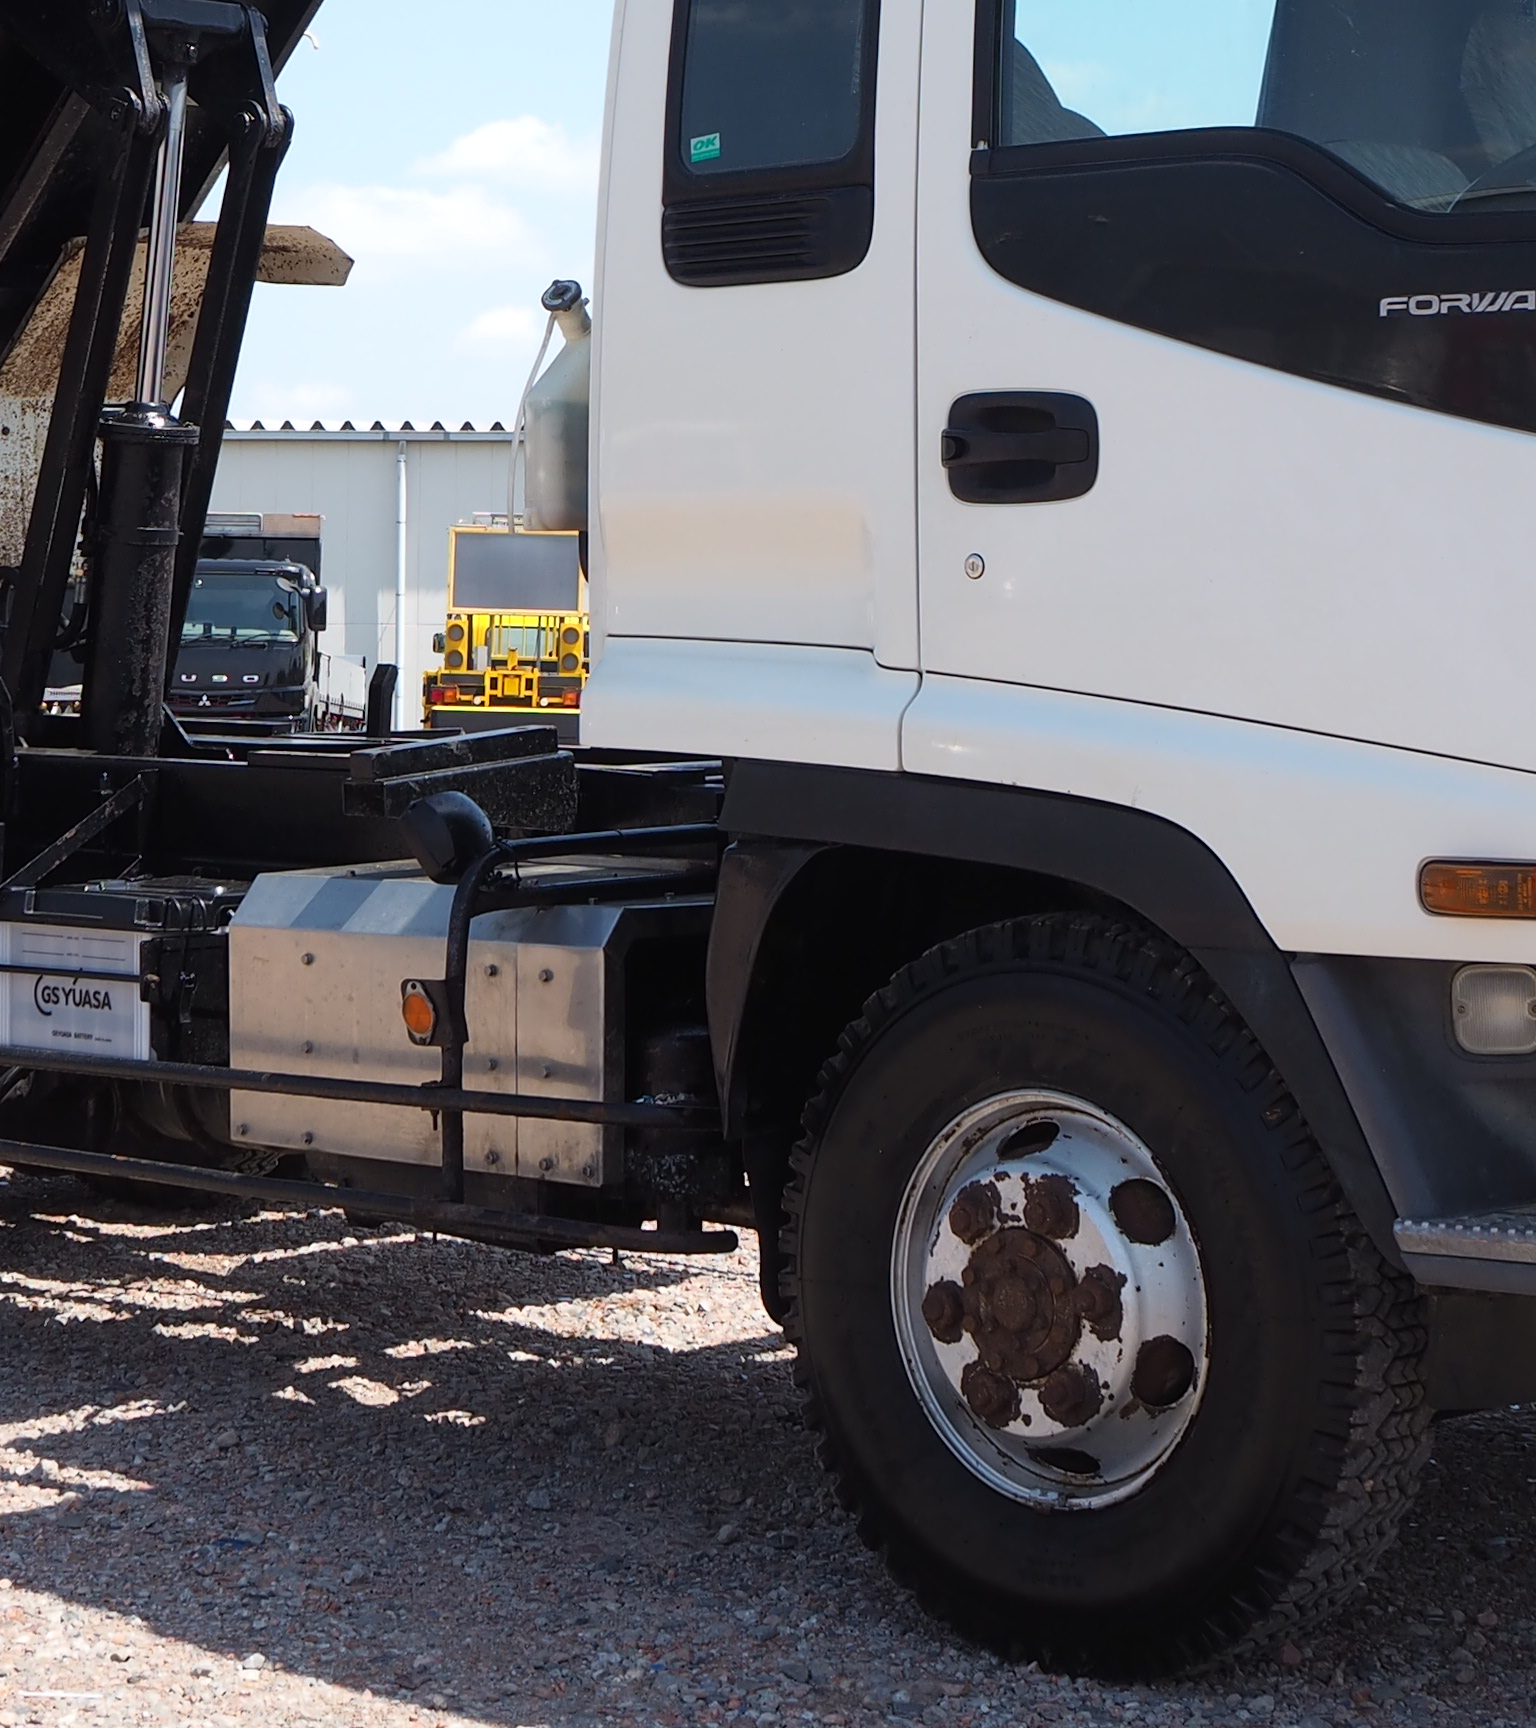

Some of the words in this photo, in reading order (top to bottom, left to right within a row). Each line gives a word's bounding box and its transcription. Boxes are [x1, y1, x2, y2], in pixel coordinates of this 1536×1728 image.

[693, 135, 718, 151] OK
[41, 985, 60, 1005] GS
[61, 986, 112, 1011] YUASA
